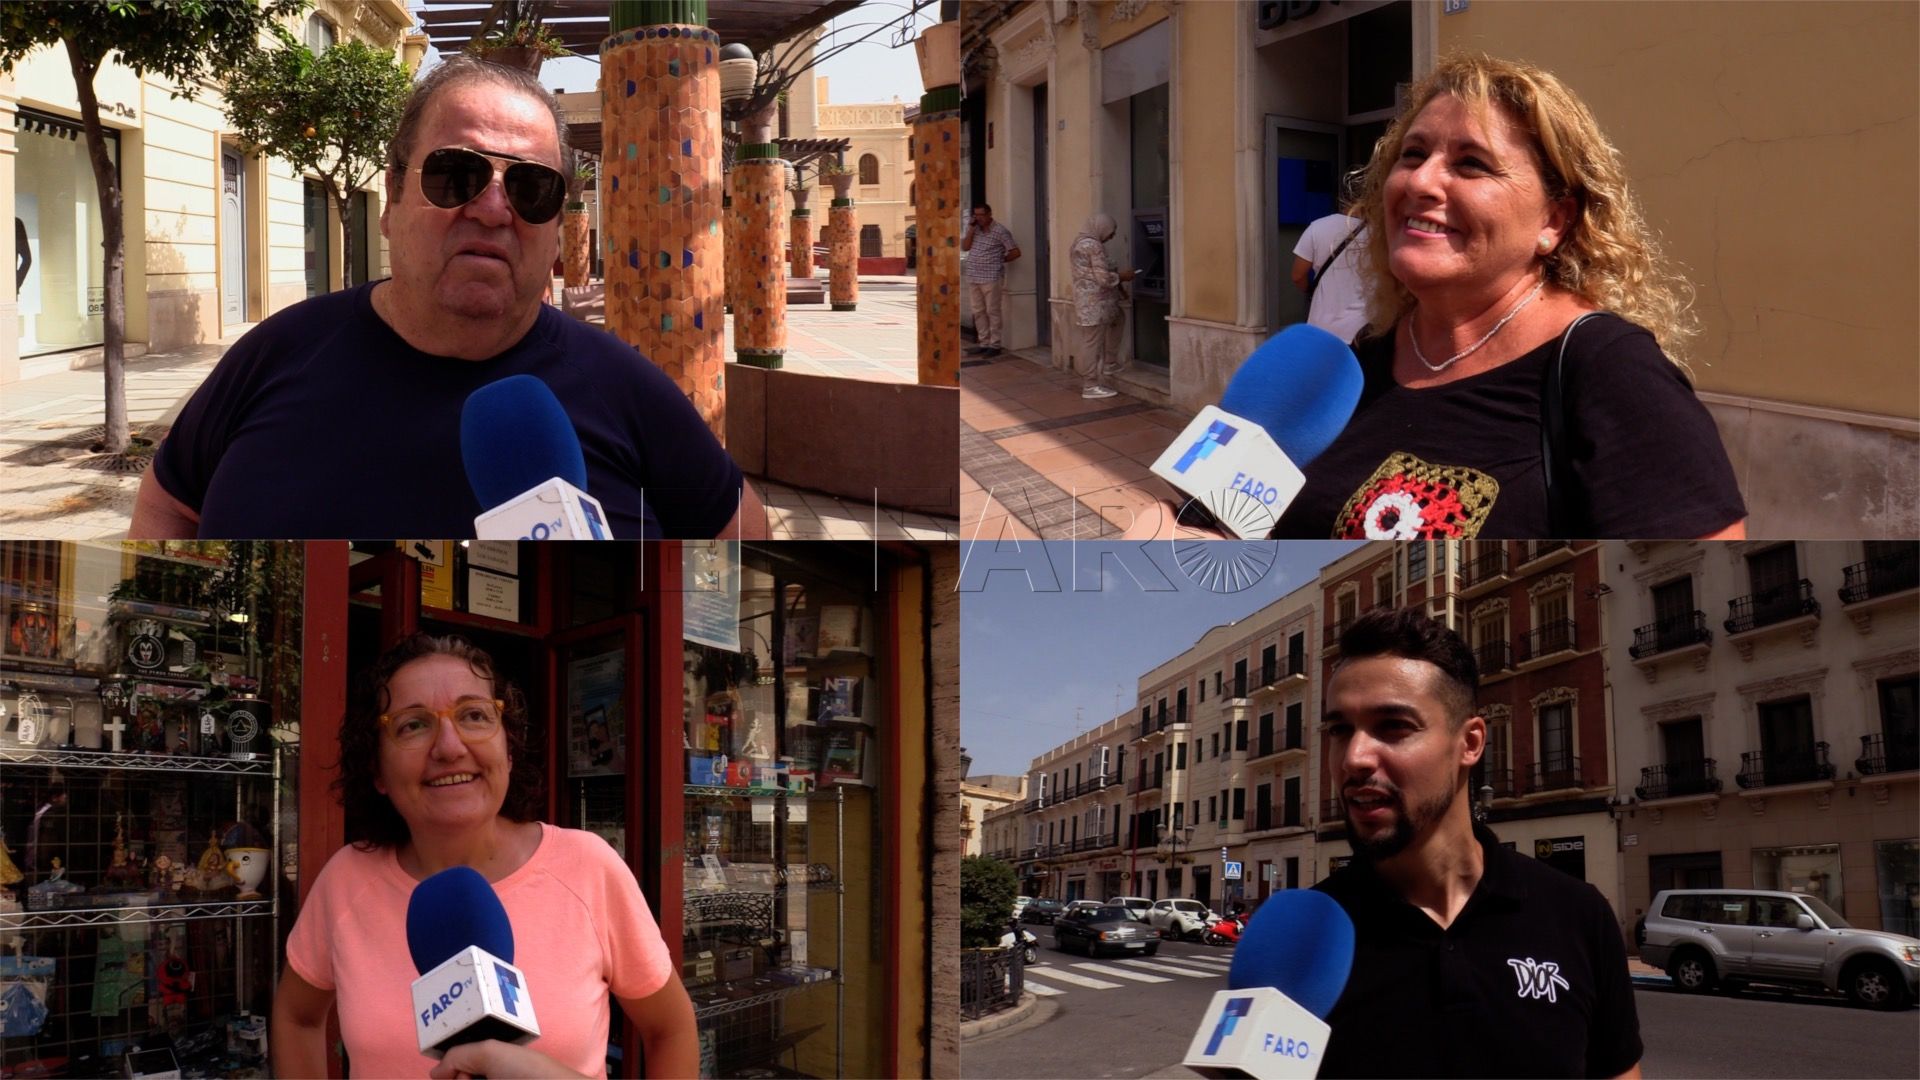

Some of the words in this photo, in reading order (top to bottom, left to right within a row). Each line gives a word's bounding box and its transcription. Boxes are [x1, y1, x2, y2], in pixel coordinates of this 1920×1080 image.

[1231, 471, 1278, 506] FARO
[421, 981, 463, 1028] FARO
[1263, 1033, 1309, 1060] FARO
